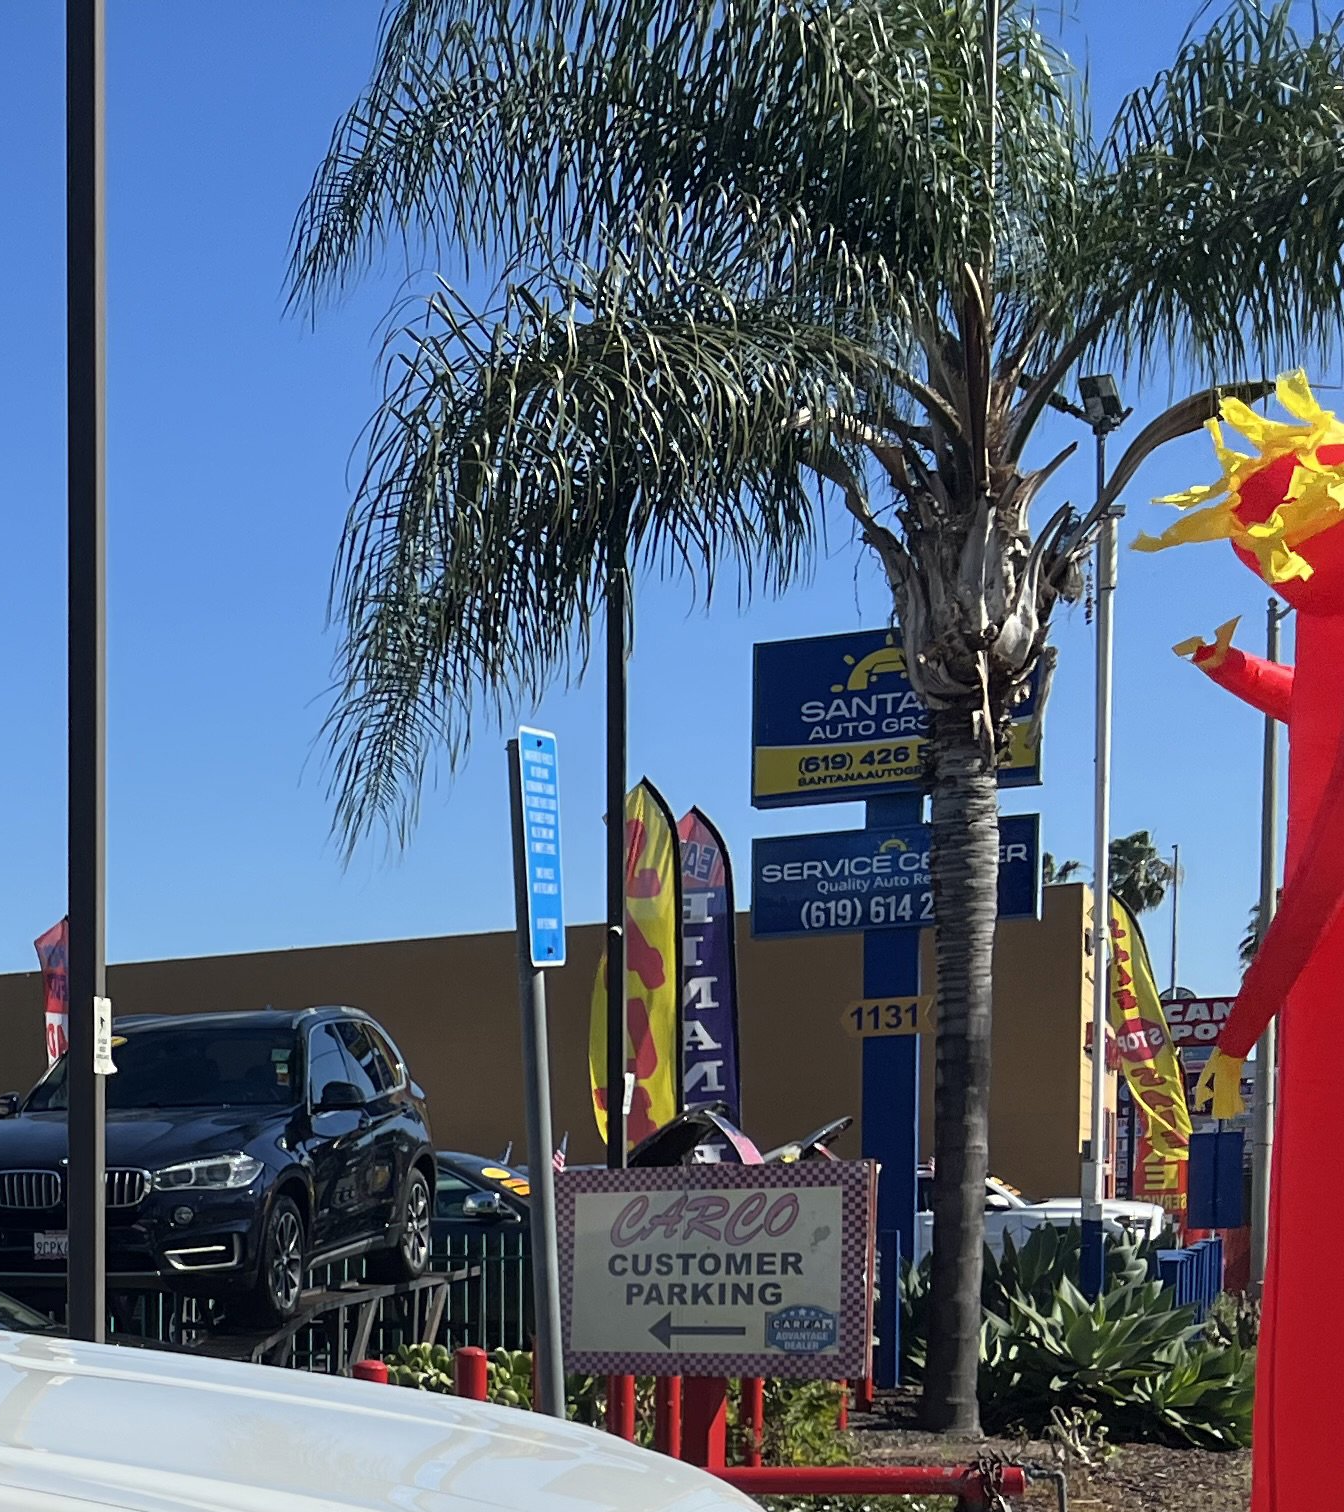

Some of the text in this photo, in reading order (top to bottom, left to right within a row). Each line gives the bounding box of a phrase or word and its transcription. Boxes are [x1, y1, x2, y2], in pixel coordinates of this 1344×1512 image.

[800, 691, 928, 723] SANTA
[808, 719, 876, 741] AUTO
[798, 752, 854, 776] (619)
[859, 746, 911, 767] 426
[762, 855, 893, 883] SERVICE
[817, 876, 871, 895] Quality
[873, 876, 910, 889] Auto
[800, 898, 863, 930] (619)
[869, 894, 914, 924] 614
[850, 1003, 919, 1031] 1131
[610, 1191, 800, 1249] CARCO
[608, 1252, 804, 1277] CUSTOMER
[626, 1282, 783, 1306] PARKING
[775, 1331, 829, 1343] ADVANTAGE
[784, 1340, 820, 1351] DEALER
